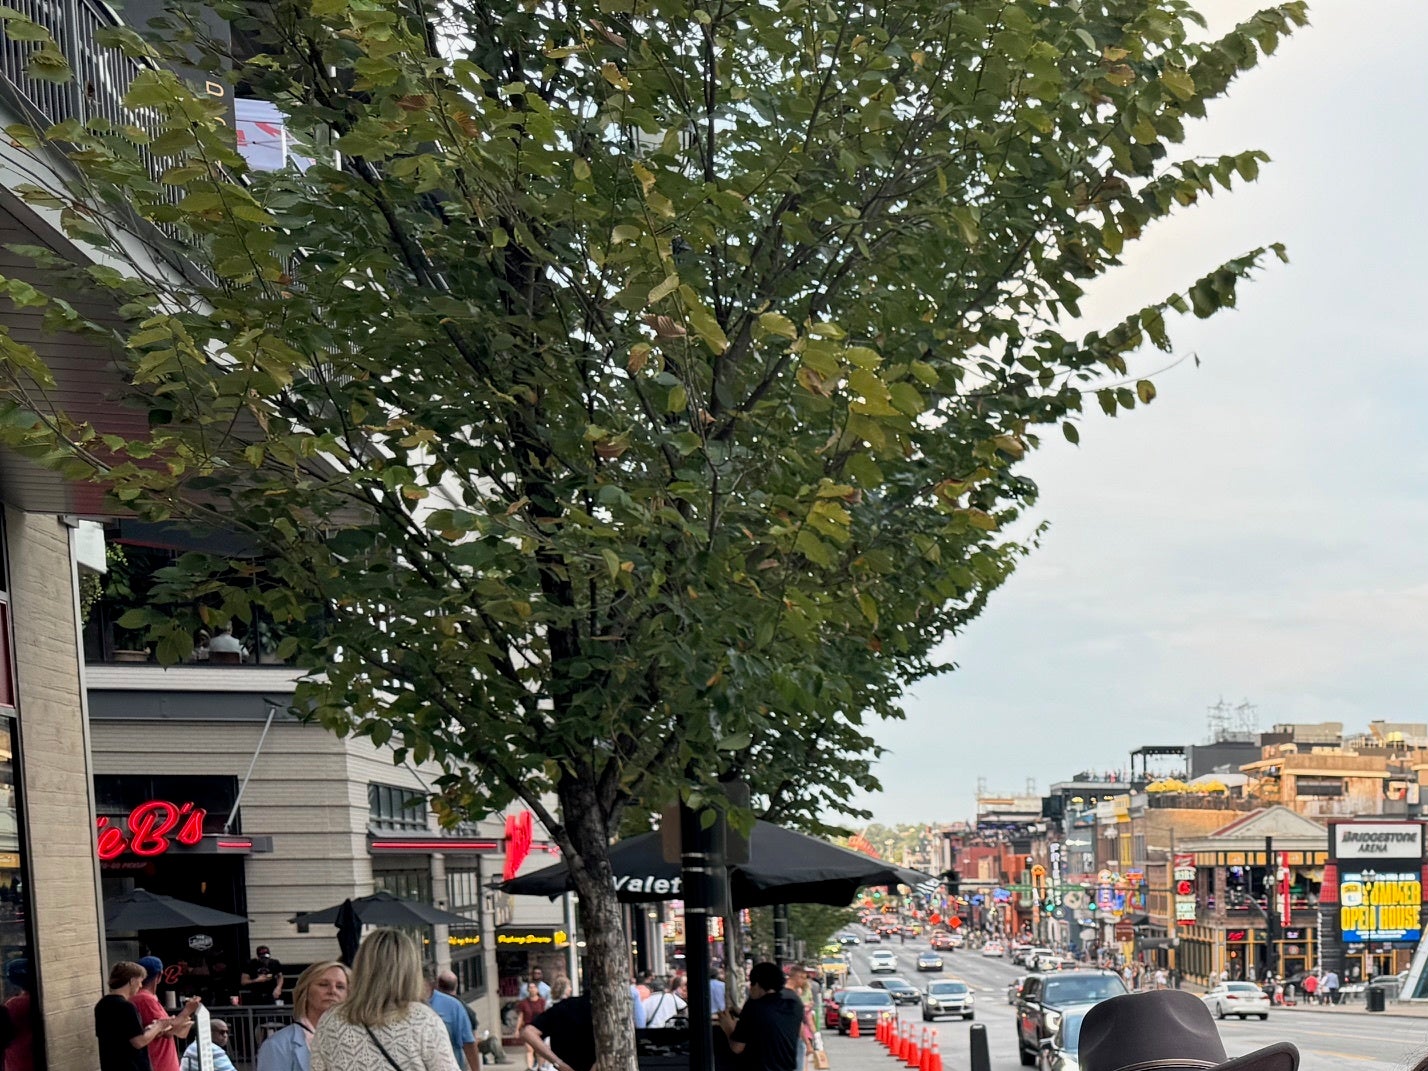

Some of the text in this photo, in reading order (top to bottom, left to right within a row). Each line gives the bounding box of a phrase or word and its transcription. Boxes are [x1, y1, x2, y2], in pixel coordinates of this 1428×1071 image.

[1342, 831, 1418, 843] BRIDGESTONE
[1358, 844, 1388, 853] ARENA
[612, 876, 682, 894] Valet
[1341, 904, 1422, 931] OPEN HOUSE
